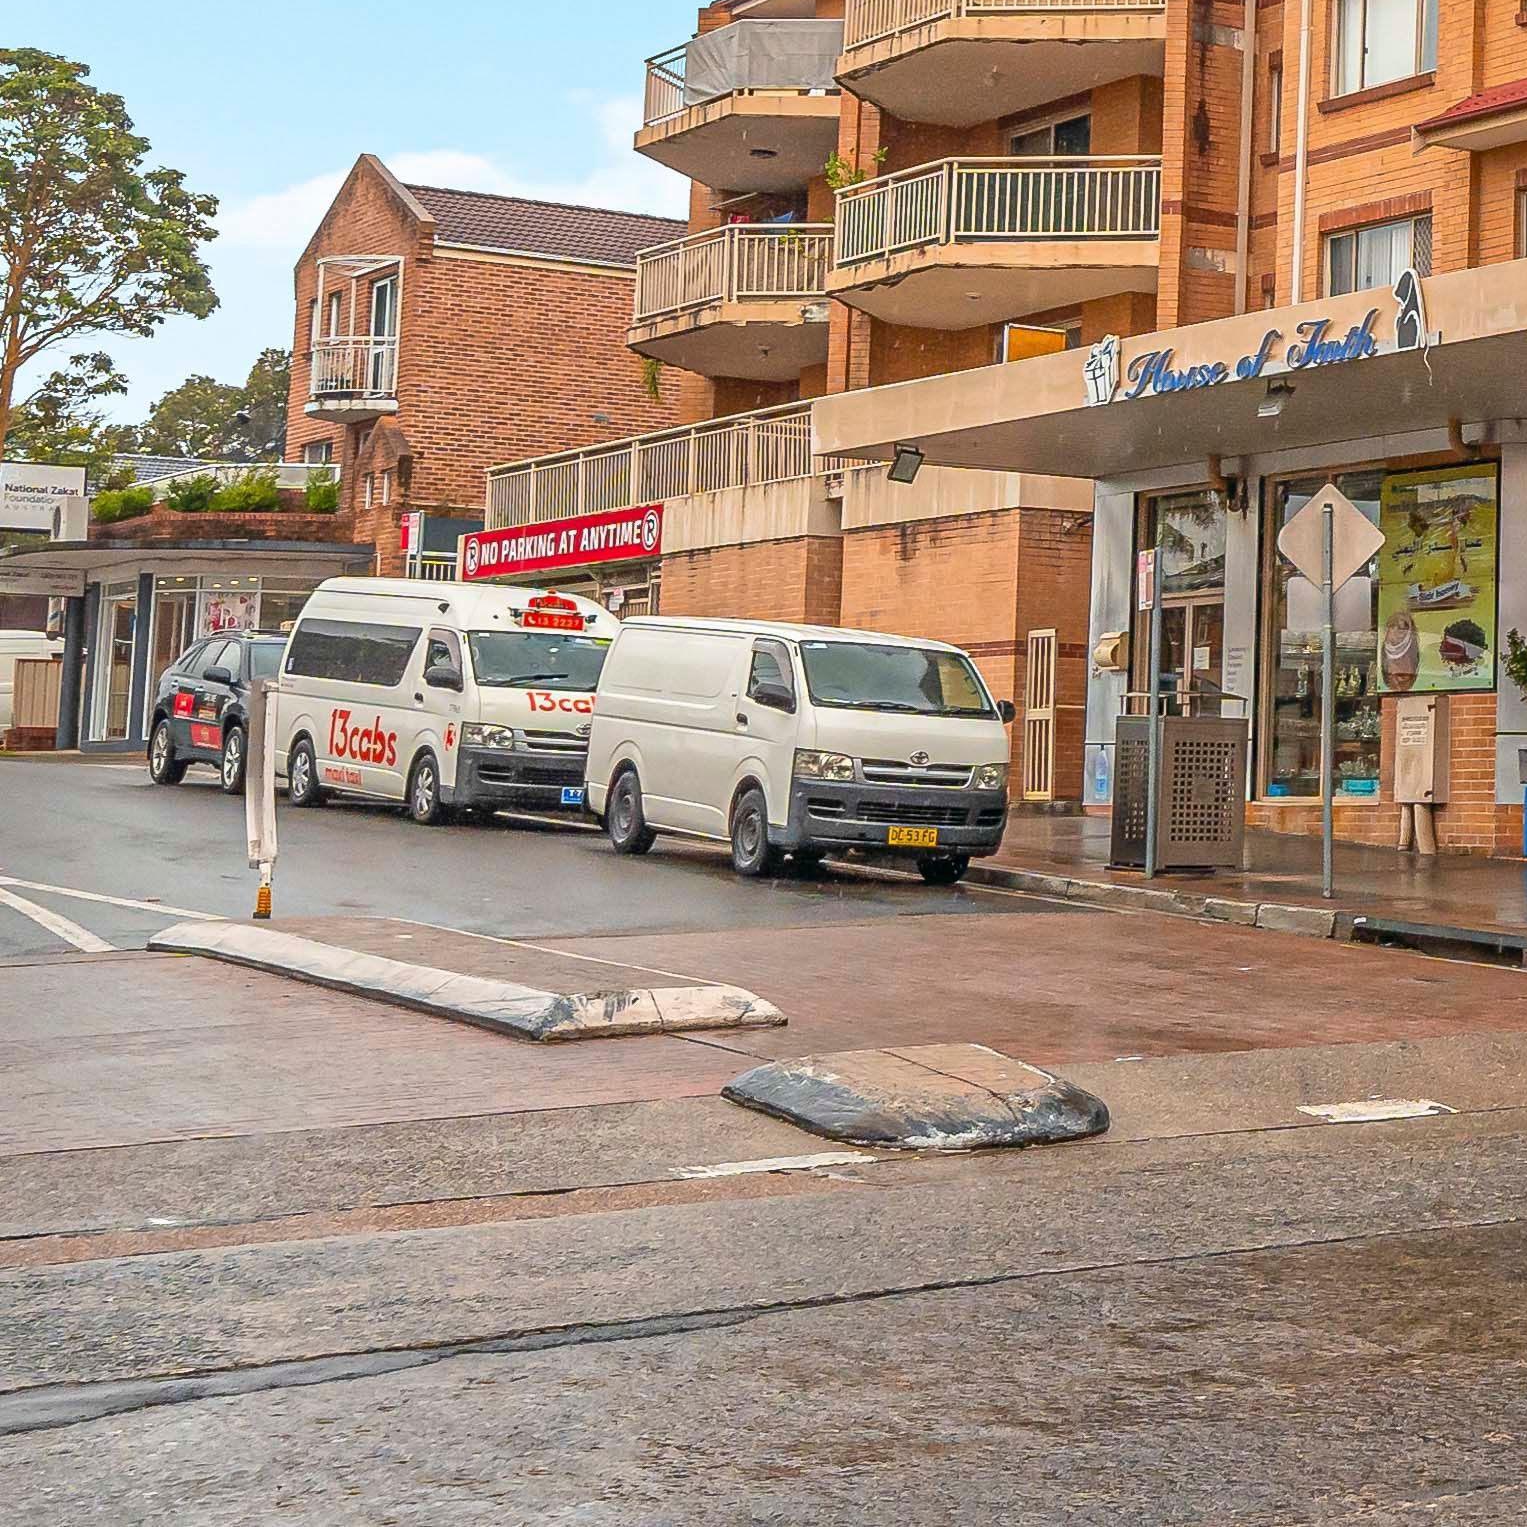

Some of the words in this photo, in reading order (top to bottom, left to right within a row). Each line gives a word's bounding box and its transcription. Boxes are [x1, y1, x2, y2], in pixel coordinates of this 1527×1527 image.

[1125, 348, 1229, 399] House
[1236, 328, 1283, 379] of
[1287, 308, 1379, 370] Faith
[3, 493, 55, 504] Foundatio
[4, 483, 48, 494] National
[51, 485, 80, 496] Zakat
[480, 541, 499, 567] NO
[501, 532, 555, 563] PARKING
[558, 529, 578, 554] AT
[579, 519, 642, 552] ANYTIME
[526, 691, 597, 714] 13ca
[328, 708, 398, 767] 13cabs
[906, 829, 920, 842] 53
